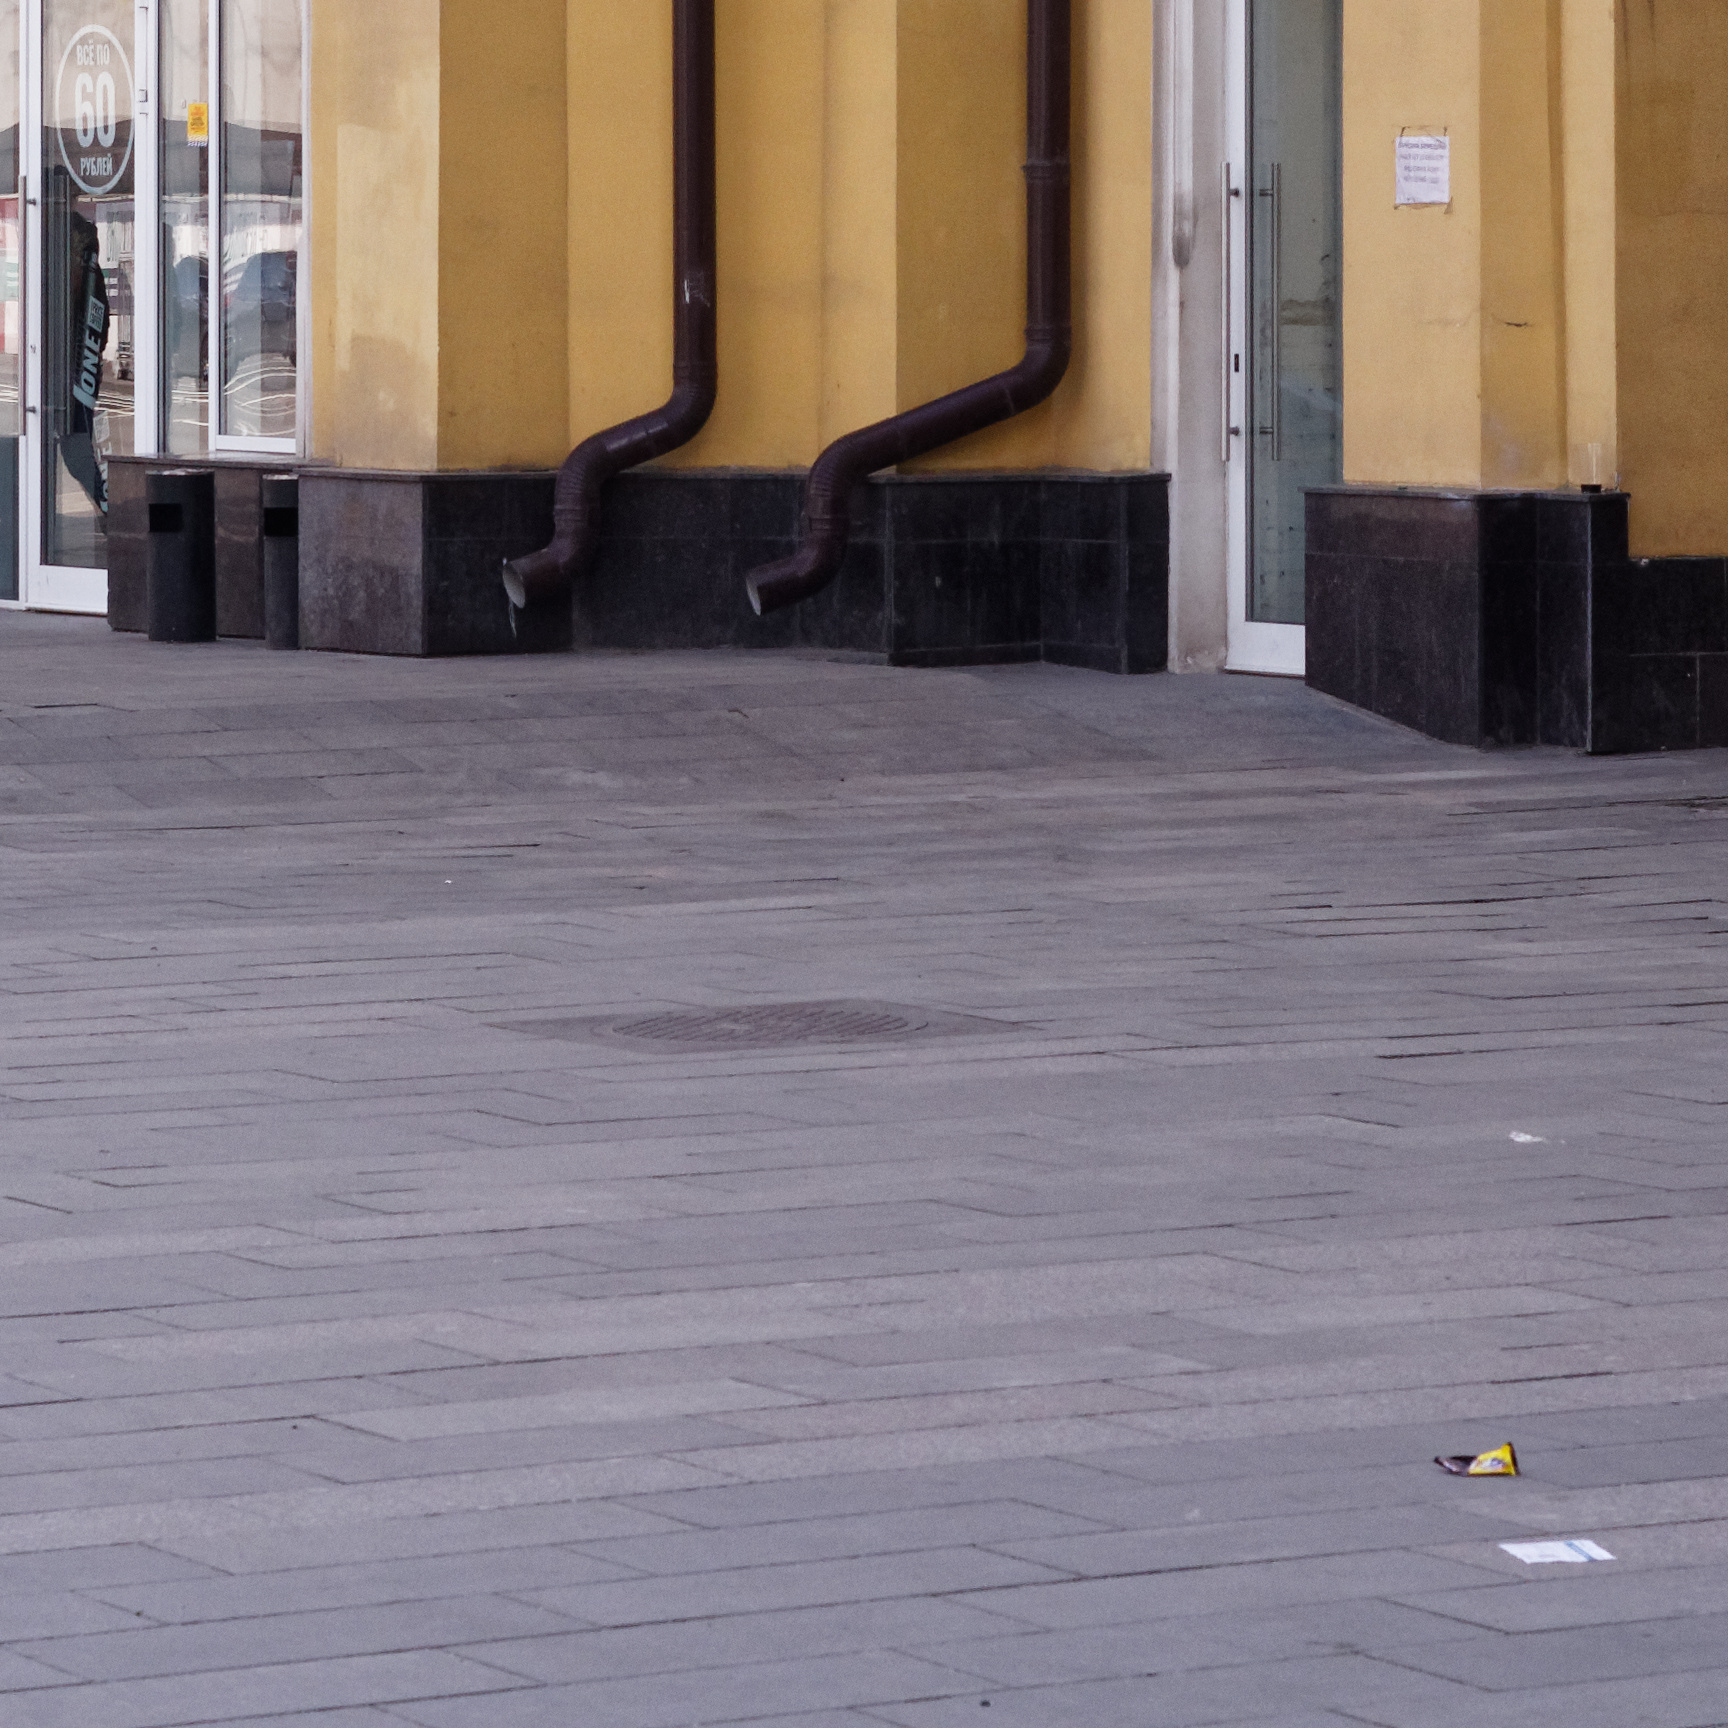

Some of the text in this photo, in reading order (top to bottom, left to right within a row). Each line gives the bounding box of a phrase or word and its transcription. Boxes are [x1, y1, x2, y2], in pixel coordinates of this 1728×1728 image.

[76, 40, 110, 66] ВСЁ ПО
[75, 71, 116, 148] 60
[80, 153, 113, 177] РУБЛЕЙ
